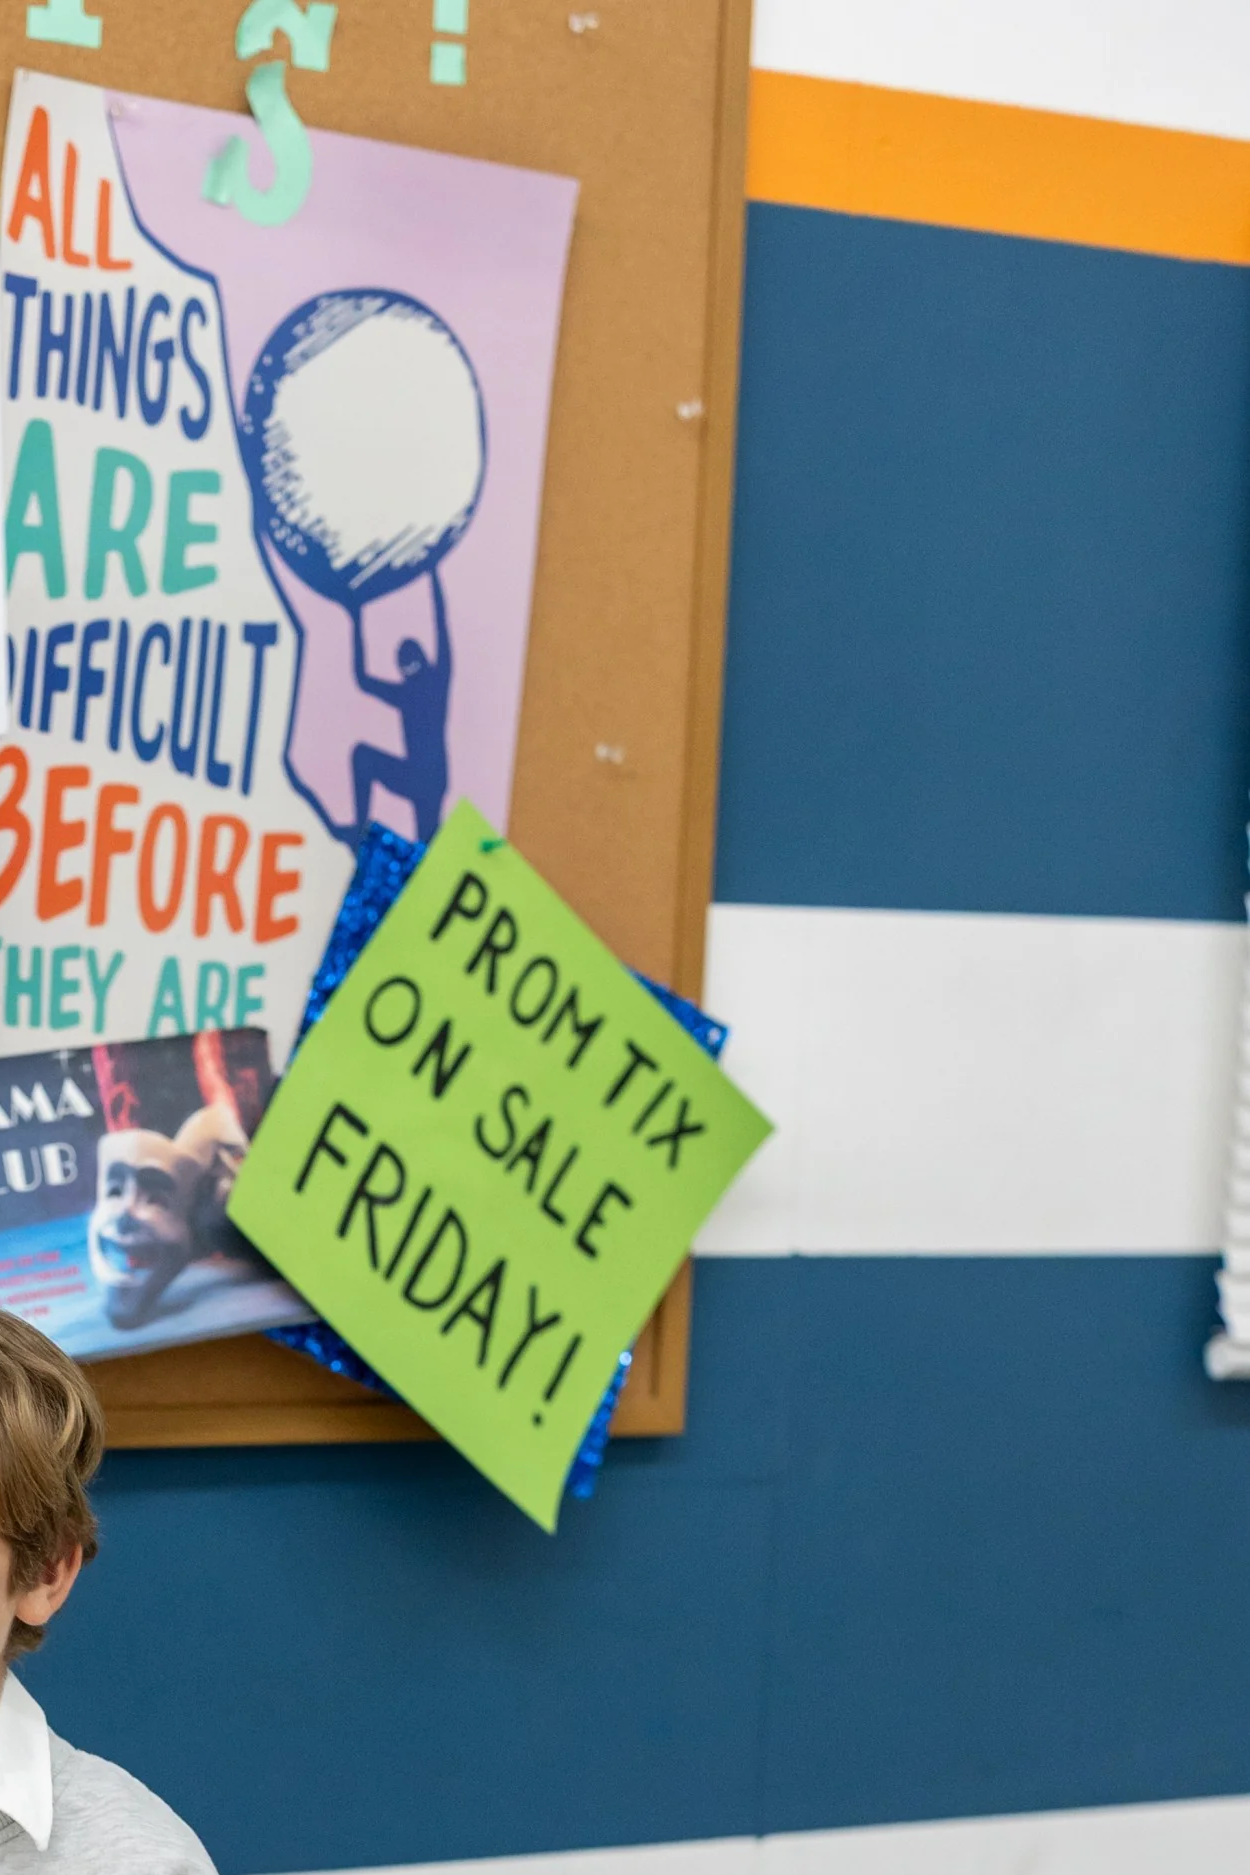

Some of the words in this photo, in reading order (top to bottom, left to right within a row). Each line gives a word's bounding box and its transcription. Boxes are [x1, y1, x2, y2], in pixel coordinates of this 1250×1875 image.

[6, 105, 133, 271] ALL
[4, 271, 212, 441] THINGS
[5, 418, 222, 600] ARE
[8, 616, 279, 797] IFFICULT
[146, 955, 266, 1039] ARE
[429, 871, 605, 1070] PROM
[604, 1040, 707, 1171] TIX
[363, 975, 472, 1102] ON
[474, 1083, 635, 1259] SALE
[293, 1101, 584, 1428] FRIDAY!
